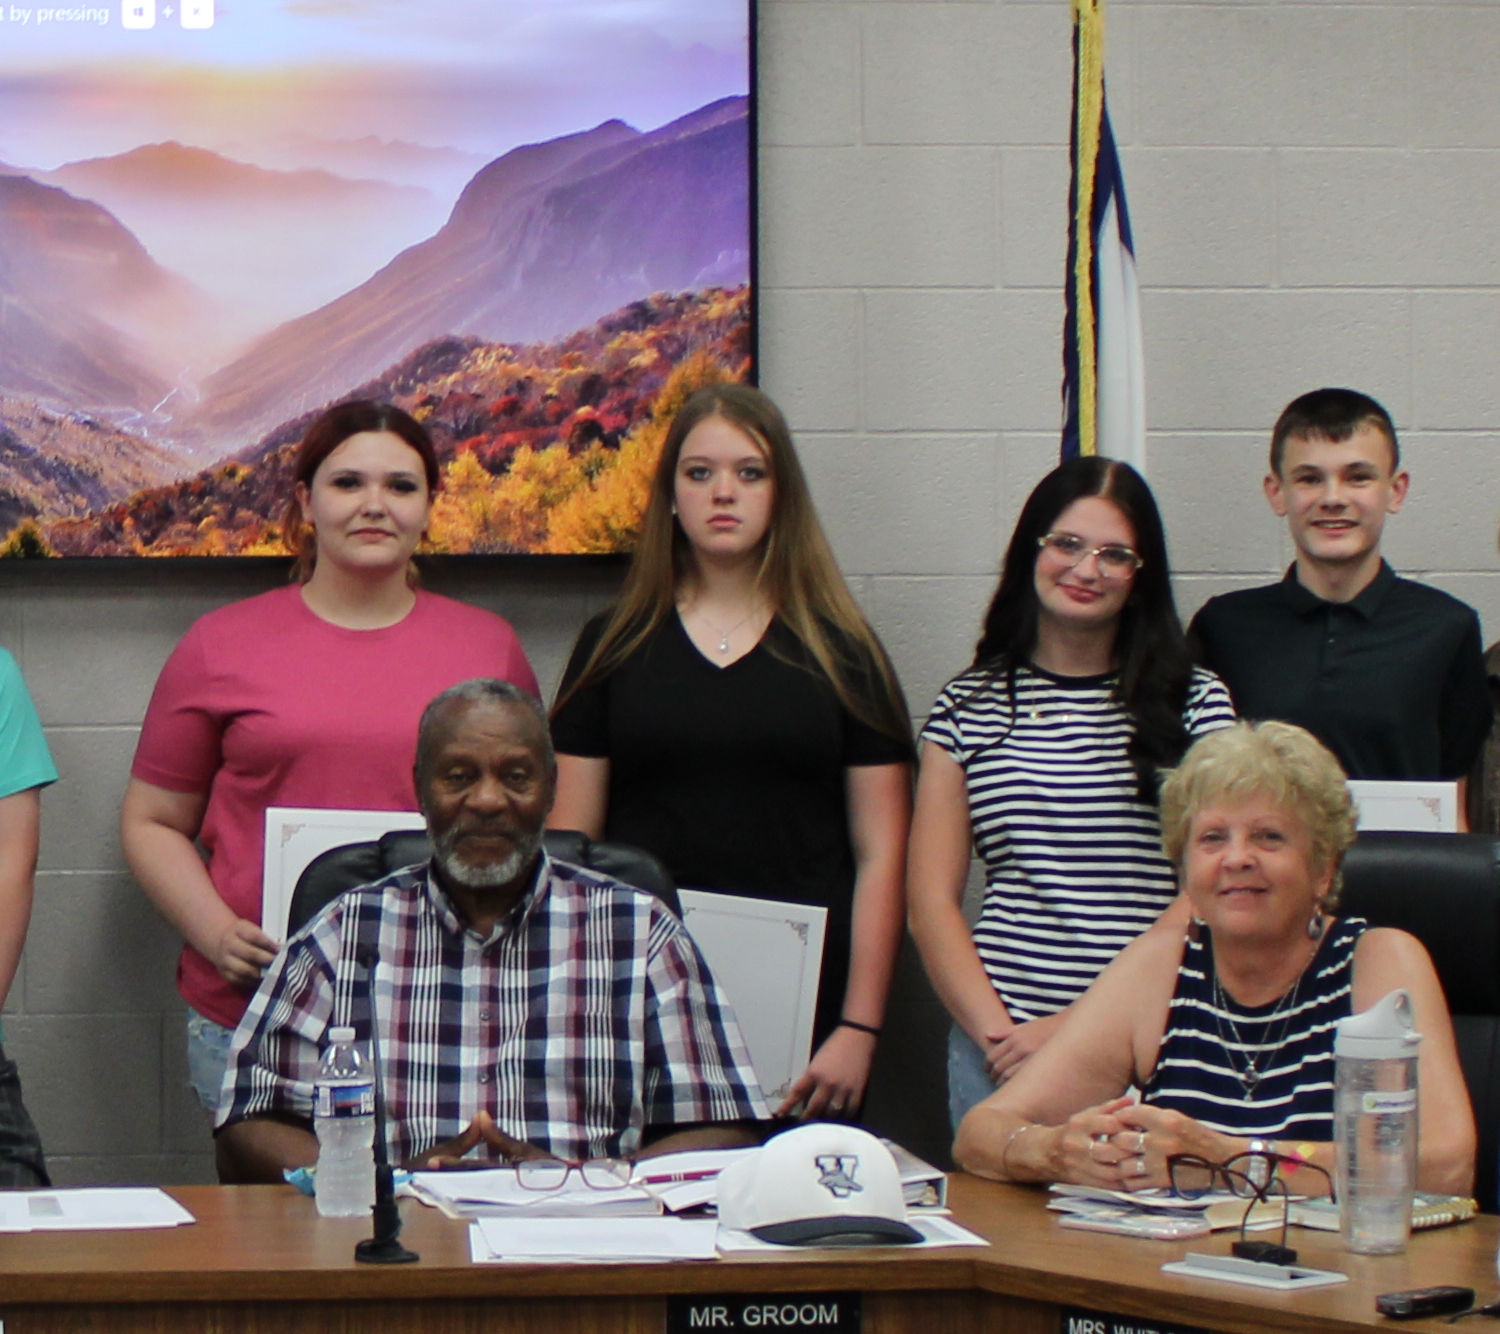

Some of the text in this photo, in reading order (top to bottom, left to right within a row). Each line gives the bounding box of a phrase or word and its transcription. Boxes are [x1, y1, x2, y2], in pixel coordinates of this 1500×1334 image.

[11, 3, 31, 26] by
[36, 3, 109, 26] pressing
[689, 1303, 838, 1328] MR. GROOM
